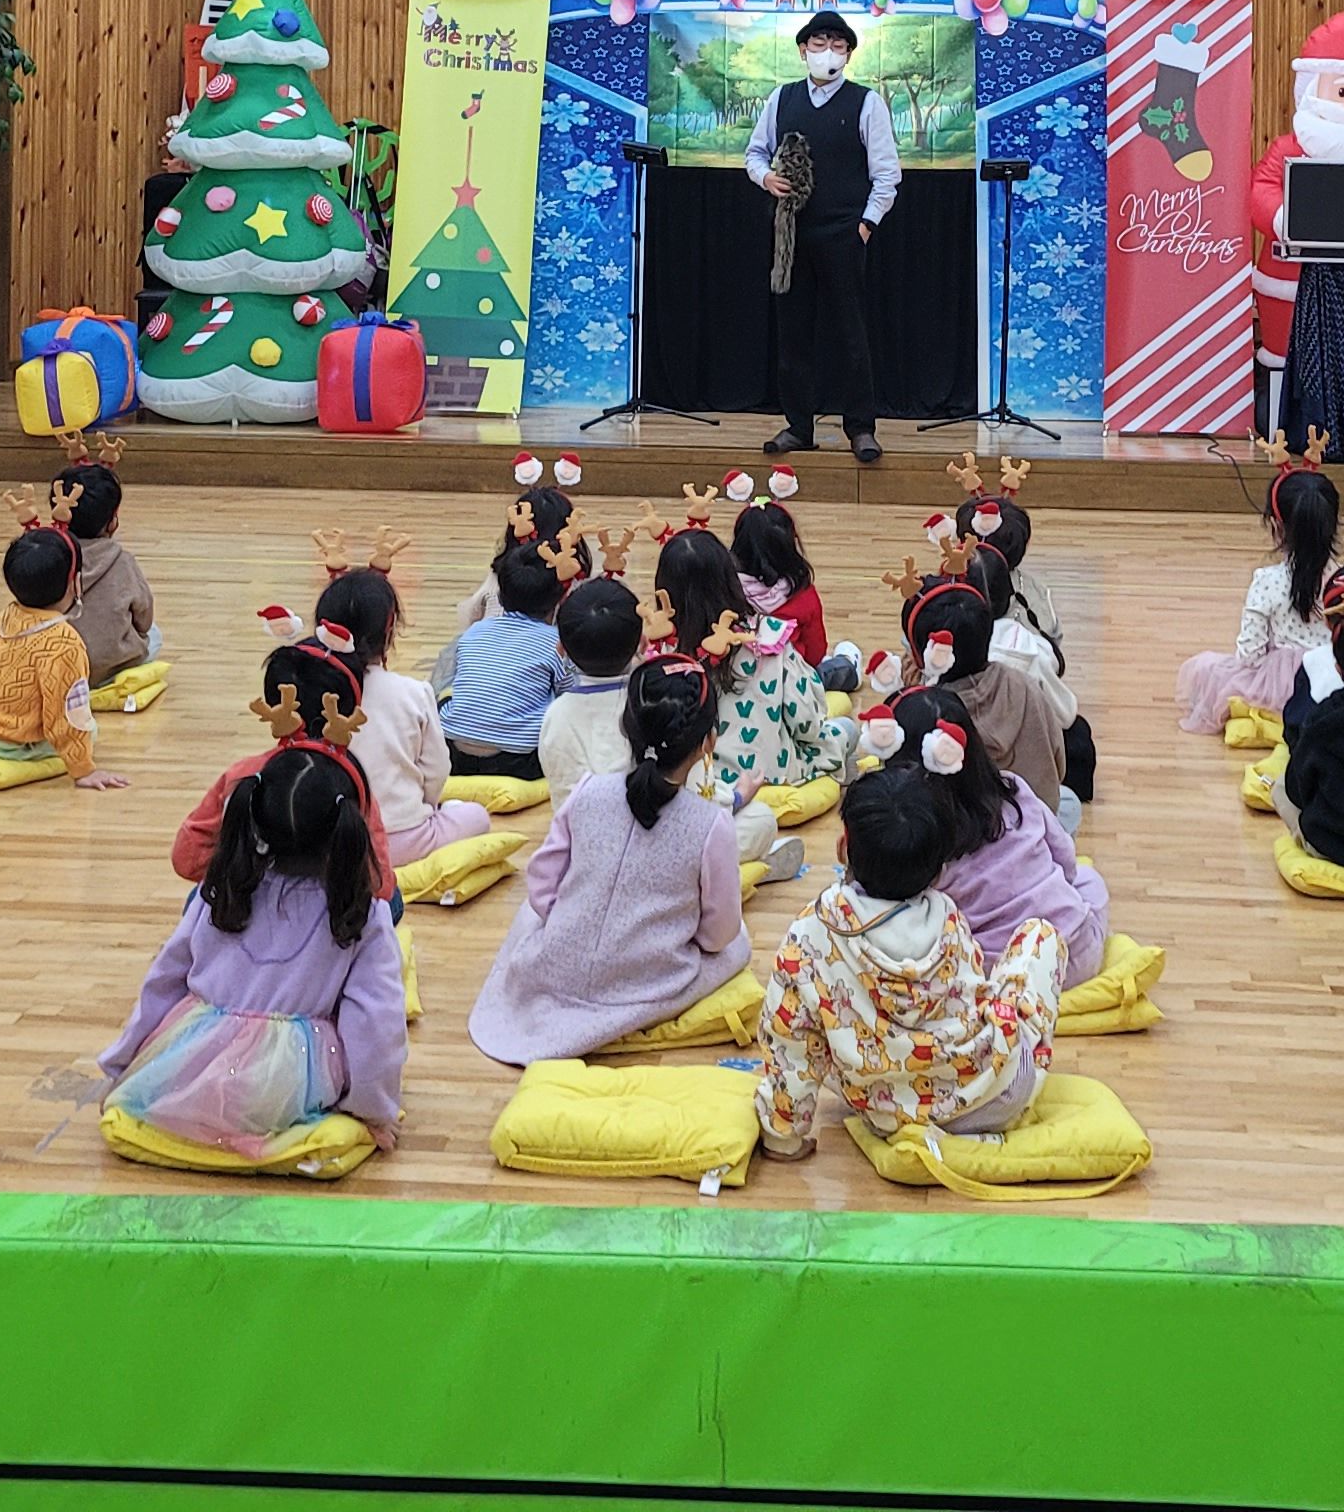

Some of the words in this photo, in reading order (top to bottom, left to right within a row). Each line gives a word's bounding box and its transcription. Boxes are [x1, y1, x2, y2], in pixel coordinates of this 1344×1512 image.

[423, 21, 498, 51] Merry
[423, 48, 538, 74] Christmas
[1119, 184, 1225, 238] Merry
[1116, 210, 1244, 274] Christmas
